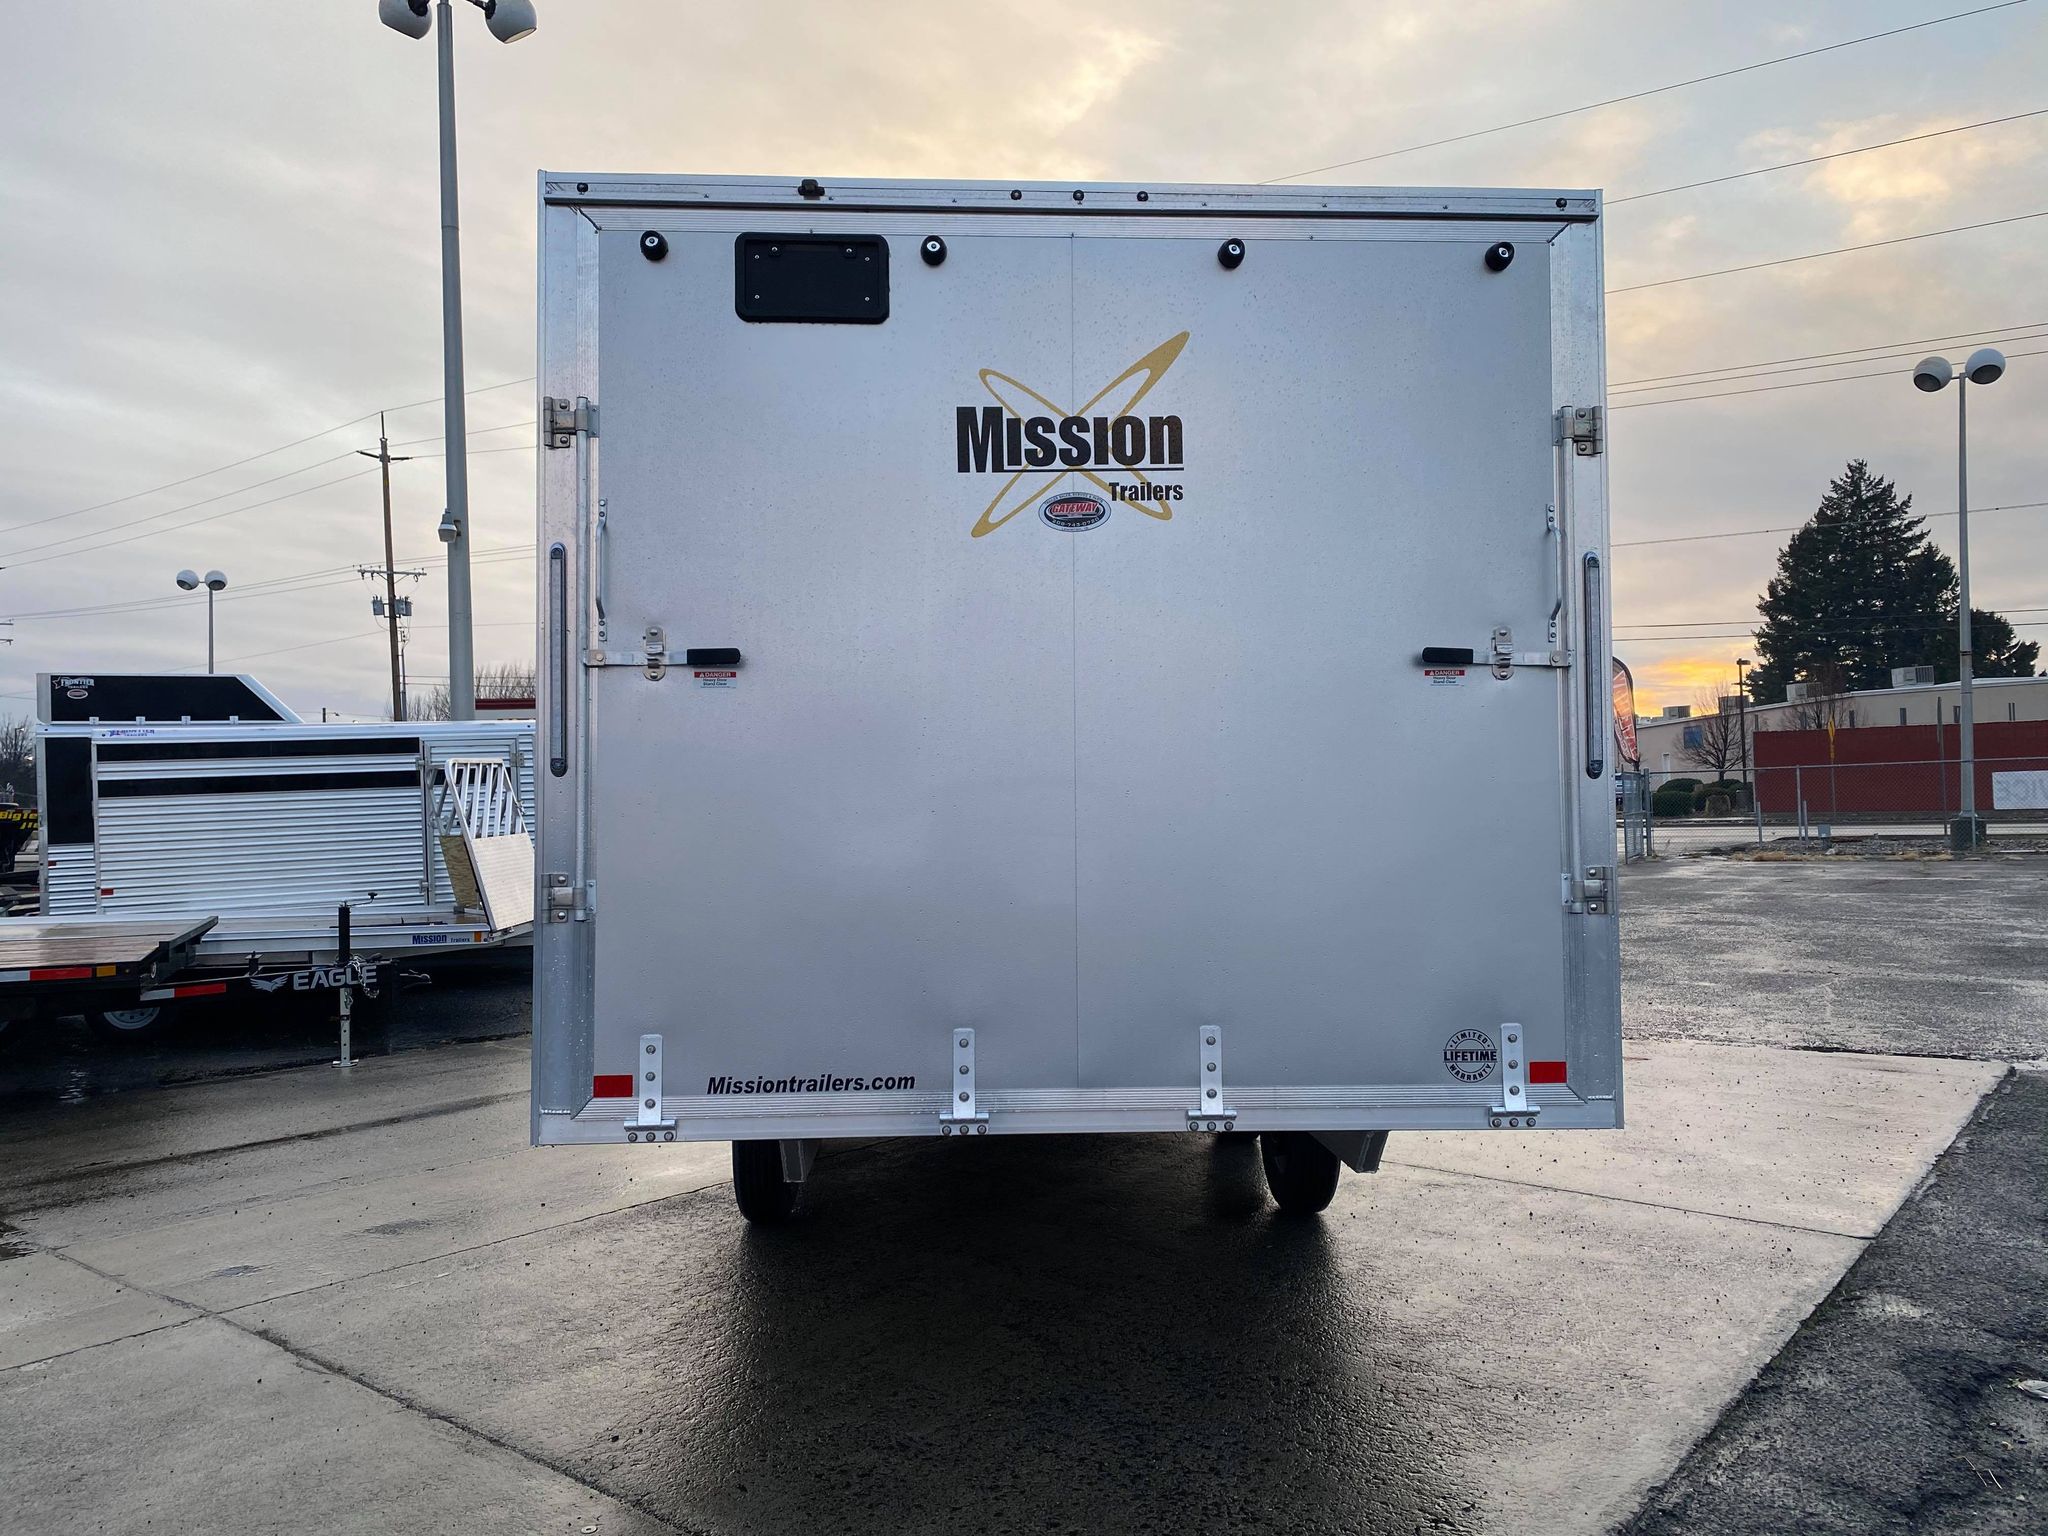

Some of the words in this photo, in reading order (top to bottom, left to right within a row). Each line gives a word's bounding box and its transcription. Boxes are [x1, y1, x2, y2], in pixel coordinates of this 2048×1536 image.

[956, 406, 1184, 473] Mission
[1109, 481, 1184, 502] Trailers
[1052, 503, 1099, 513] GATEWAY
[60, 677, 95, 686] FRONTIER
[412, 934, 447, 945] Mission
[293, 965, 377, 991] EAGLE
[1451, 1031, 1489, 1045] LIMITED
[1443, 1051, 1498, 1061] LIFETIME
[1450, 1064, 1492, 1081] WARRANTY
[707, 1073, 916, 1095] Missiontrailers.com
